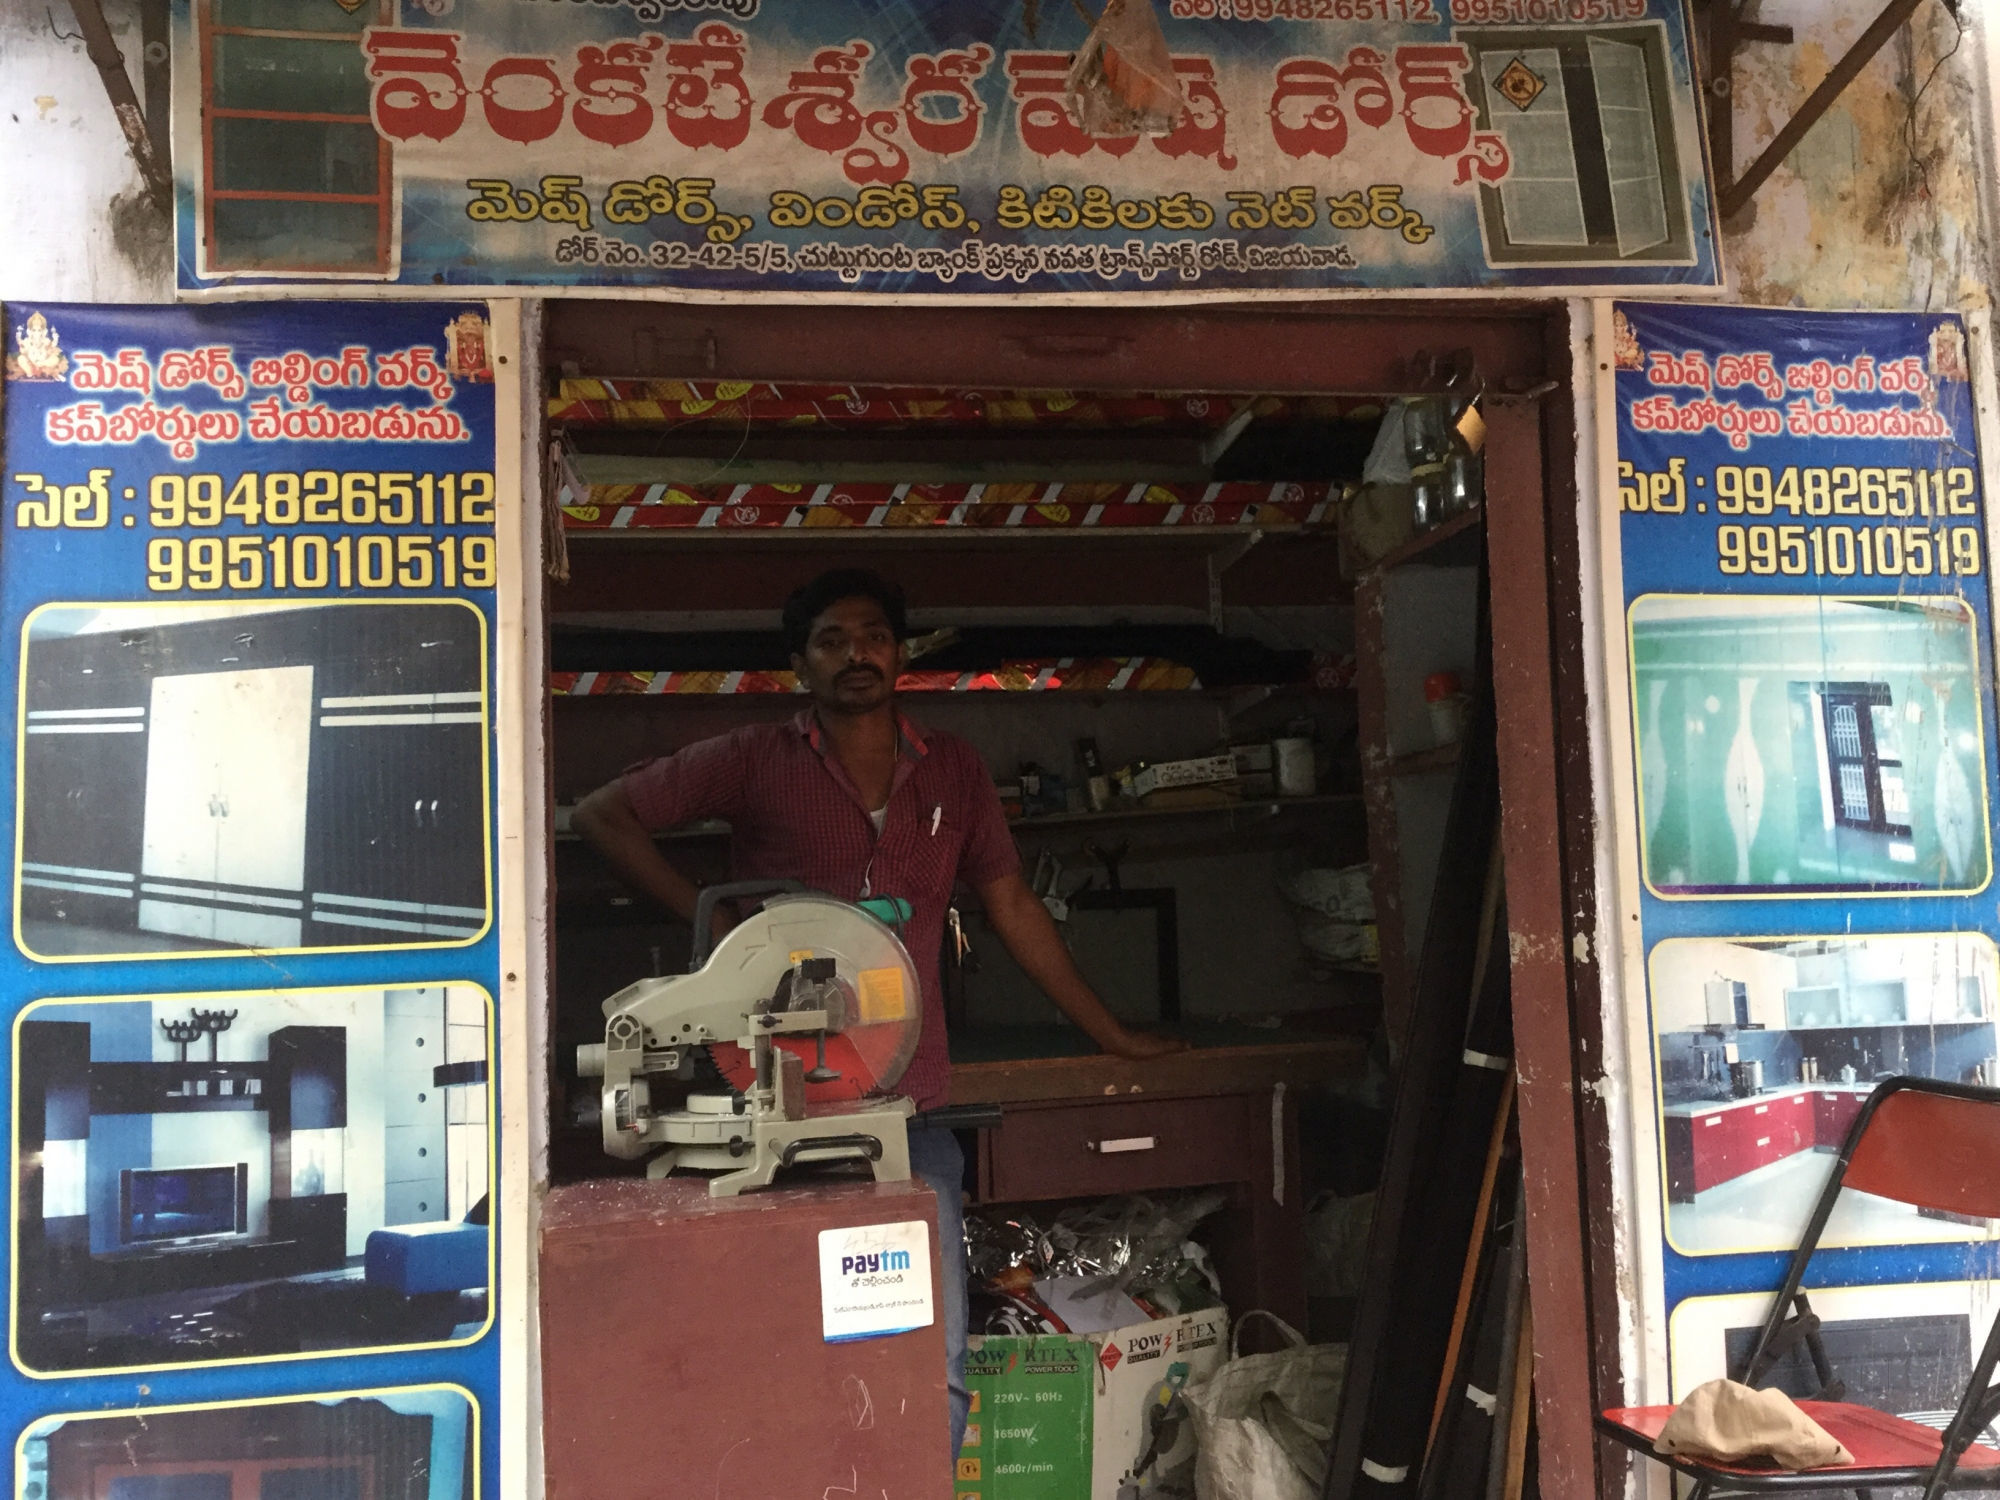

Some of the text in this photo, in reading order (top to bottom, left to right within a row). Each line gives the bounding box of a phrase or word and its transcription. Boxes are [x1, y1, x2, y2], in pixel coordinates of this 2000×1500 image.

[1269, 45, 1509, 185] డోర్స్
[467, 176, 593, 231] మెష్
[769, 182, 980, 232] విండోస్,
[997, 185, 1214, 229] కిటికిలకు
[1227, 186, 1315, 230] నెట్
[1326, 184, 1434, 243] వర్క్
[557, 239, 599, 263] డోర్
[653, 244, 793, 272] 32-42-5/5,
[919, 242, 981, 279] బ్యాంక్
[1046, 248, 1095, 268] నవత
[73, 347, 453, 403] మెష్ డోర్స్ బిల్డింగ్ వర్క్
[1650, 353, 1710, 392] మెష్
[1716, 354, 1783, 399] డోర్స్
[249, 397, 470, 440] చేయబడును.
[15, 470, 113, 528] సెల్
[149, 472, 495, 525] 9948265112
[1716, 466, 1976, 516] 9948265112
[148, 535, 496, 591] 9951010519
[1718, 525, 1981, 575] 9951010519
